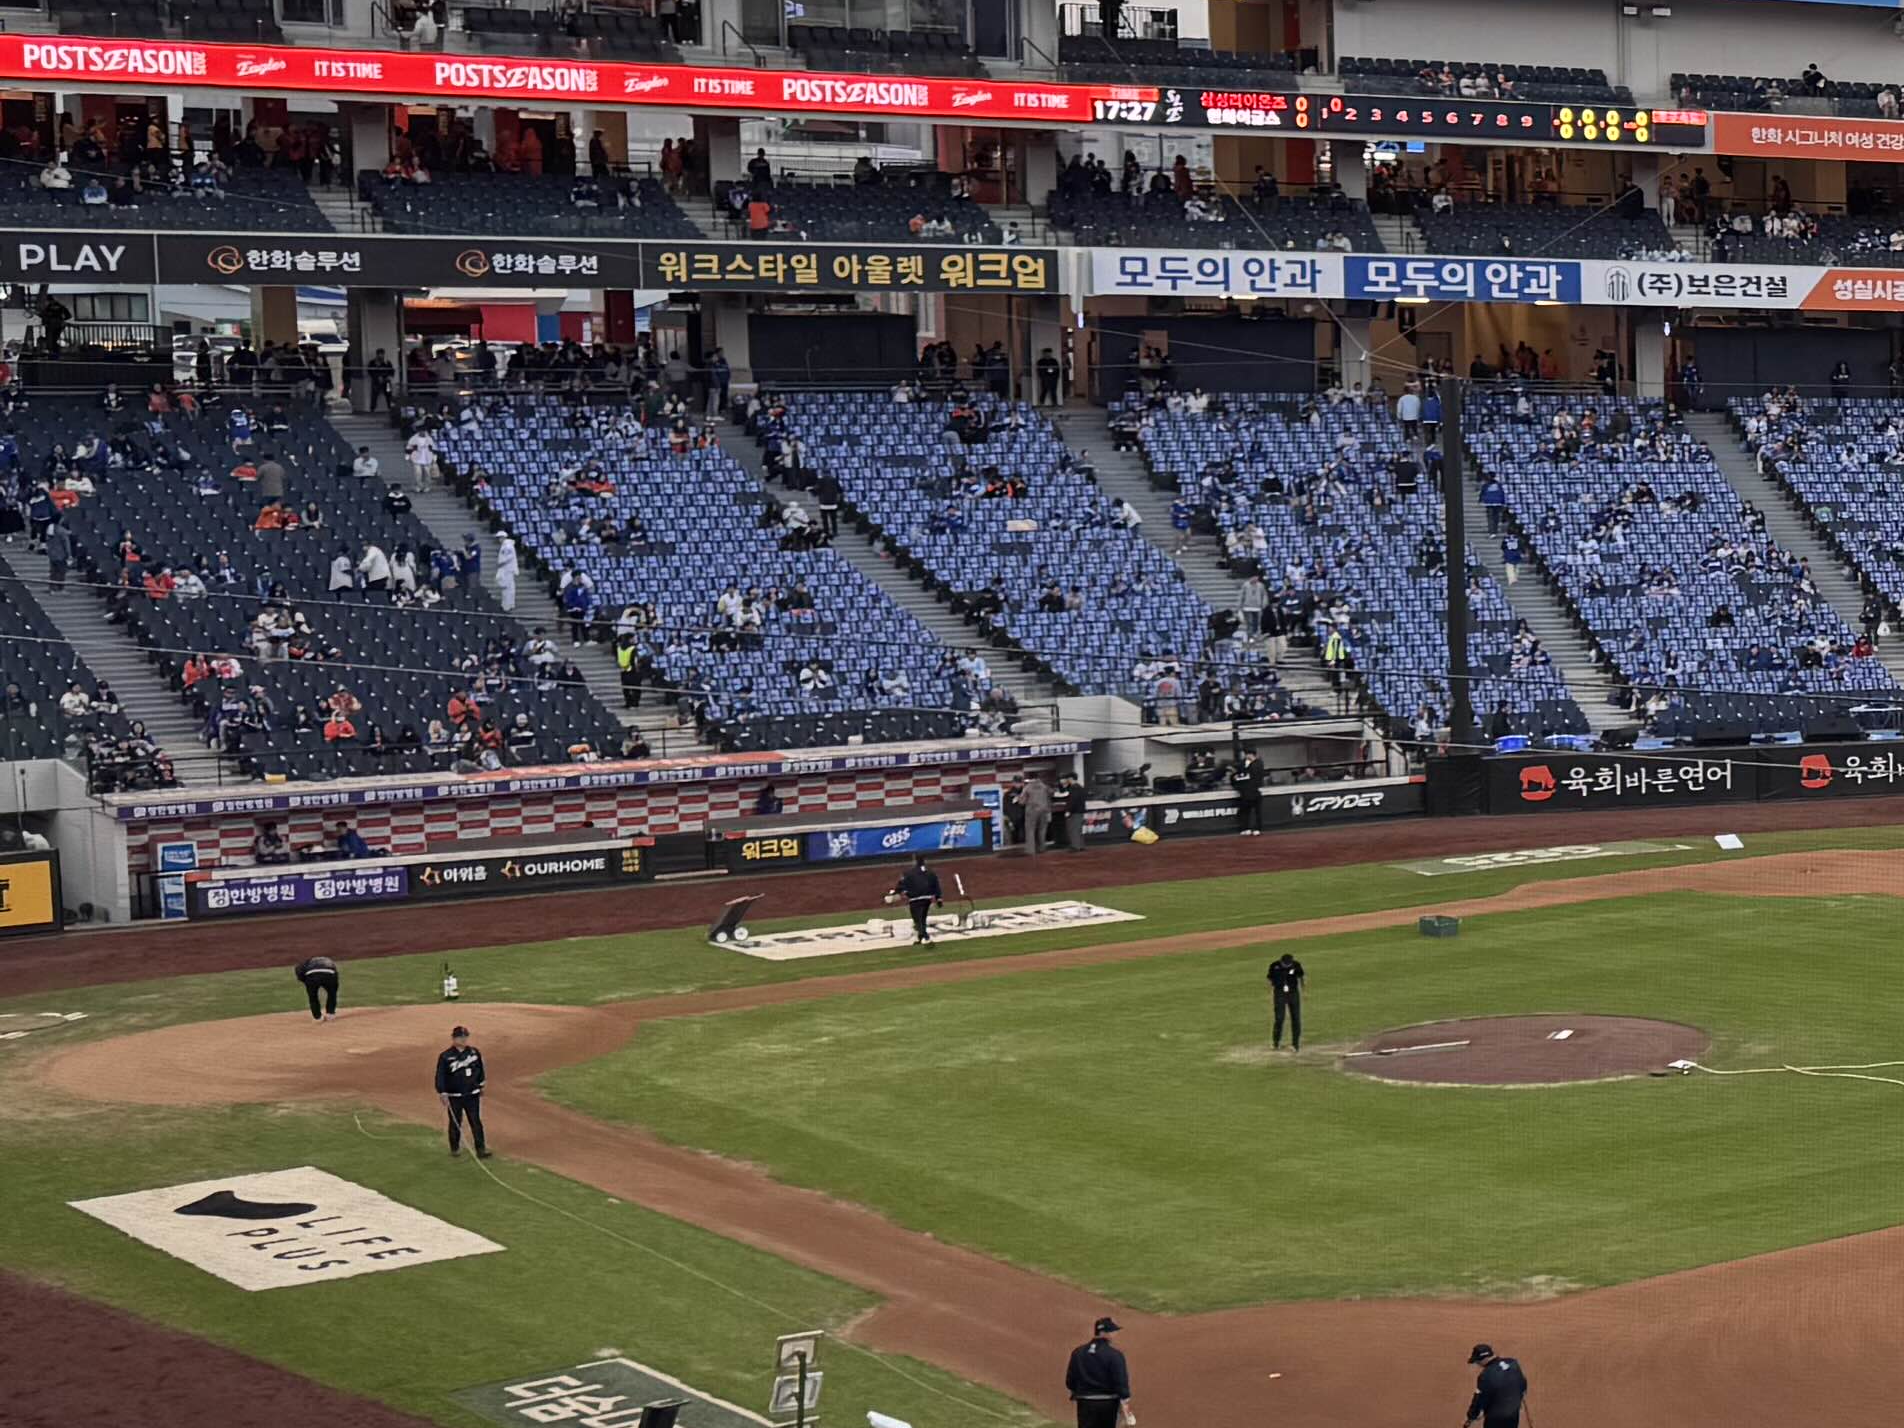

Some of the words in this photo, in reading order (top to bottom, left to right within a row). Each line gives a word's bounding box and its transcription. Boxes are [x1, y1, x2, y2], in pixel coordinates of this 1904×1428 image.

[1094, 100, 1156, 121] 17:27
[1345, 108, 1357, 120] 2
[1371, 109, 1382, 121] 3
[1396, 110, 1408, 122] 4
[1422, 111, 1433, 123] 5
[1446, 112, 1459, 124] 6
[1472, 113, 1484, 125] 7
[1496, 114, 1508, 126] 8
[1521, 115, 1533, 127] 9
[1751, 127, 1783, 146] 한화
[1785, 127, 1842, 147] 시그니처
[1845, 129, 1873, 149] 여성
[19, 244, 126, 272] PLAY
[247, 248, 361, 272] 한화솔루션
[492, 251, 598, 275] 한화솔루션
[658, 250, 819, 284] 워크스타일
[833, 253, 925, 285] 아울렛
[939, 253, 1047, 289] 워크업
[1115, 255, 1231, 291] 모두의
[1243, 257, 1322, 293] 안과
[1364, 261, 1475, 297] 모두의
[1485, 262, 1562, 300] 안과
[1636, 271, 1790, 301] (주)보은건설
[1561, 760, 1733, 797] 육회바른연어
[1307, 792, 1384, 812] SPYDER
[740, 838, 799, 860] 워크업
[443, 866, 488, 883] 아워홈
[523, 857, 606, 876] OURHOME
[208, 885, 295, 908] 정한방병원
[314, 878, 400, 900] 정한방병원
[299, 1214, 421, 1262] LIFE
[225, 1227, 352, 1274] PLUS
